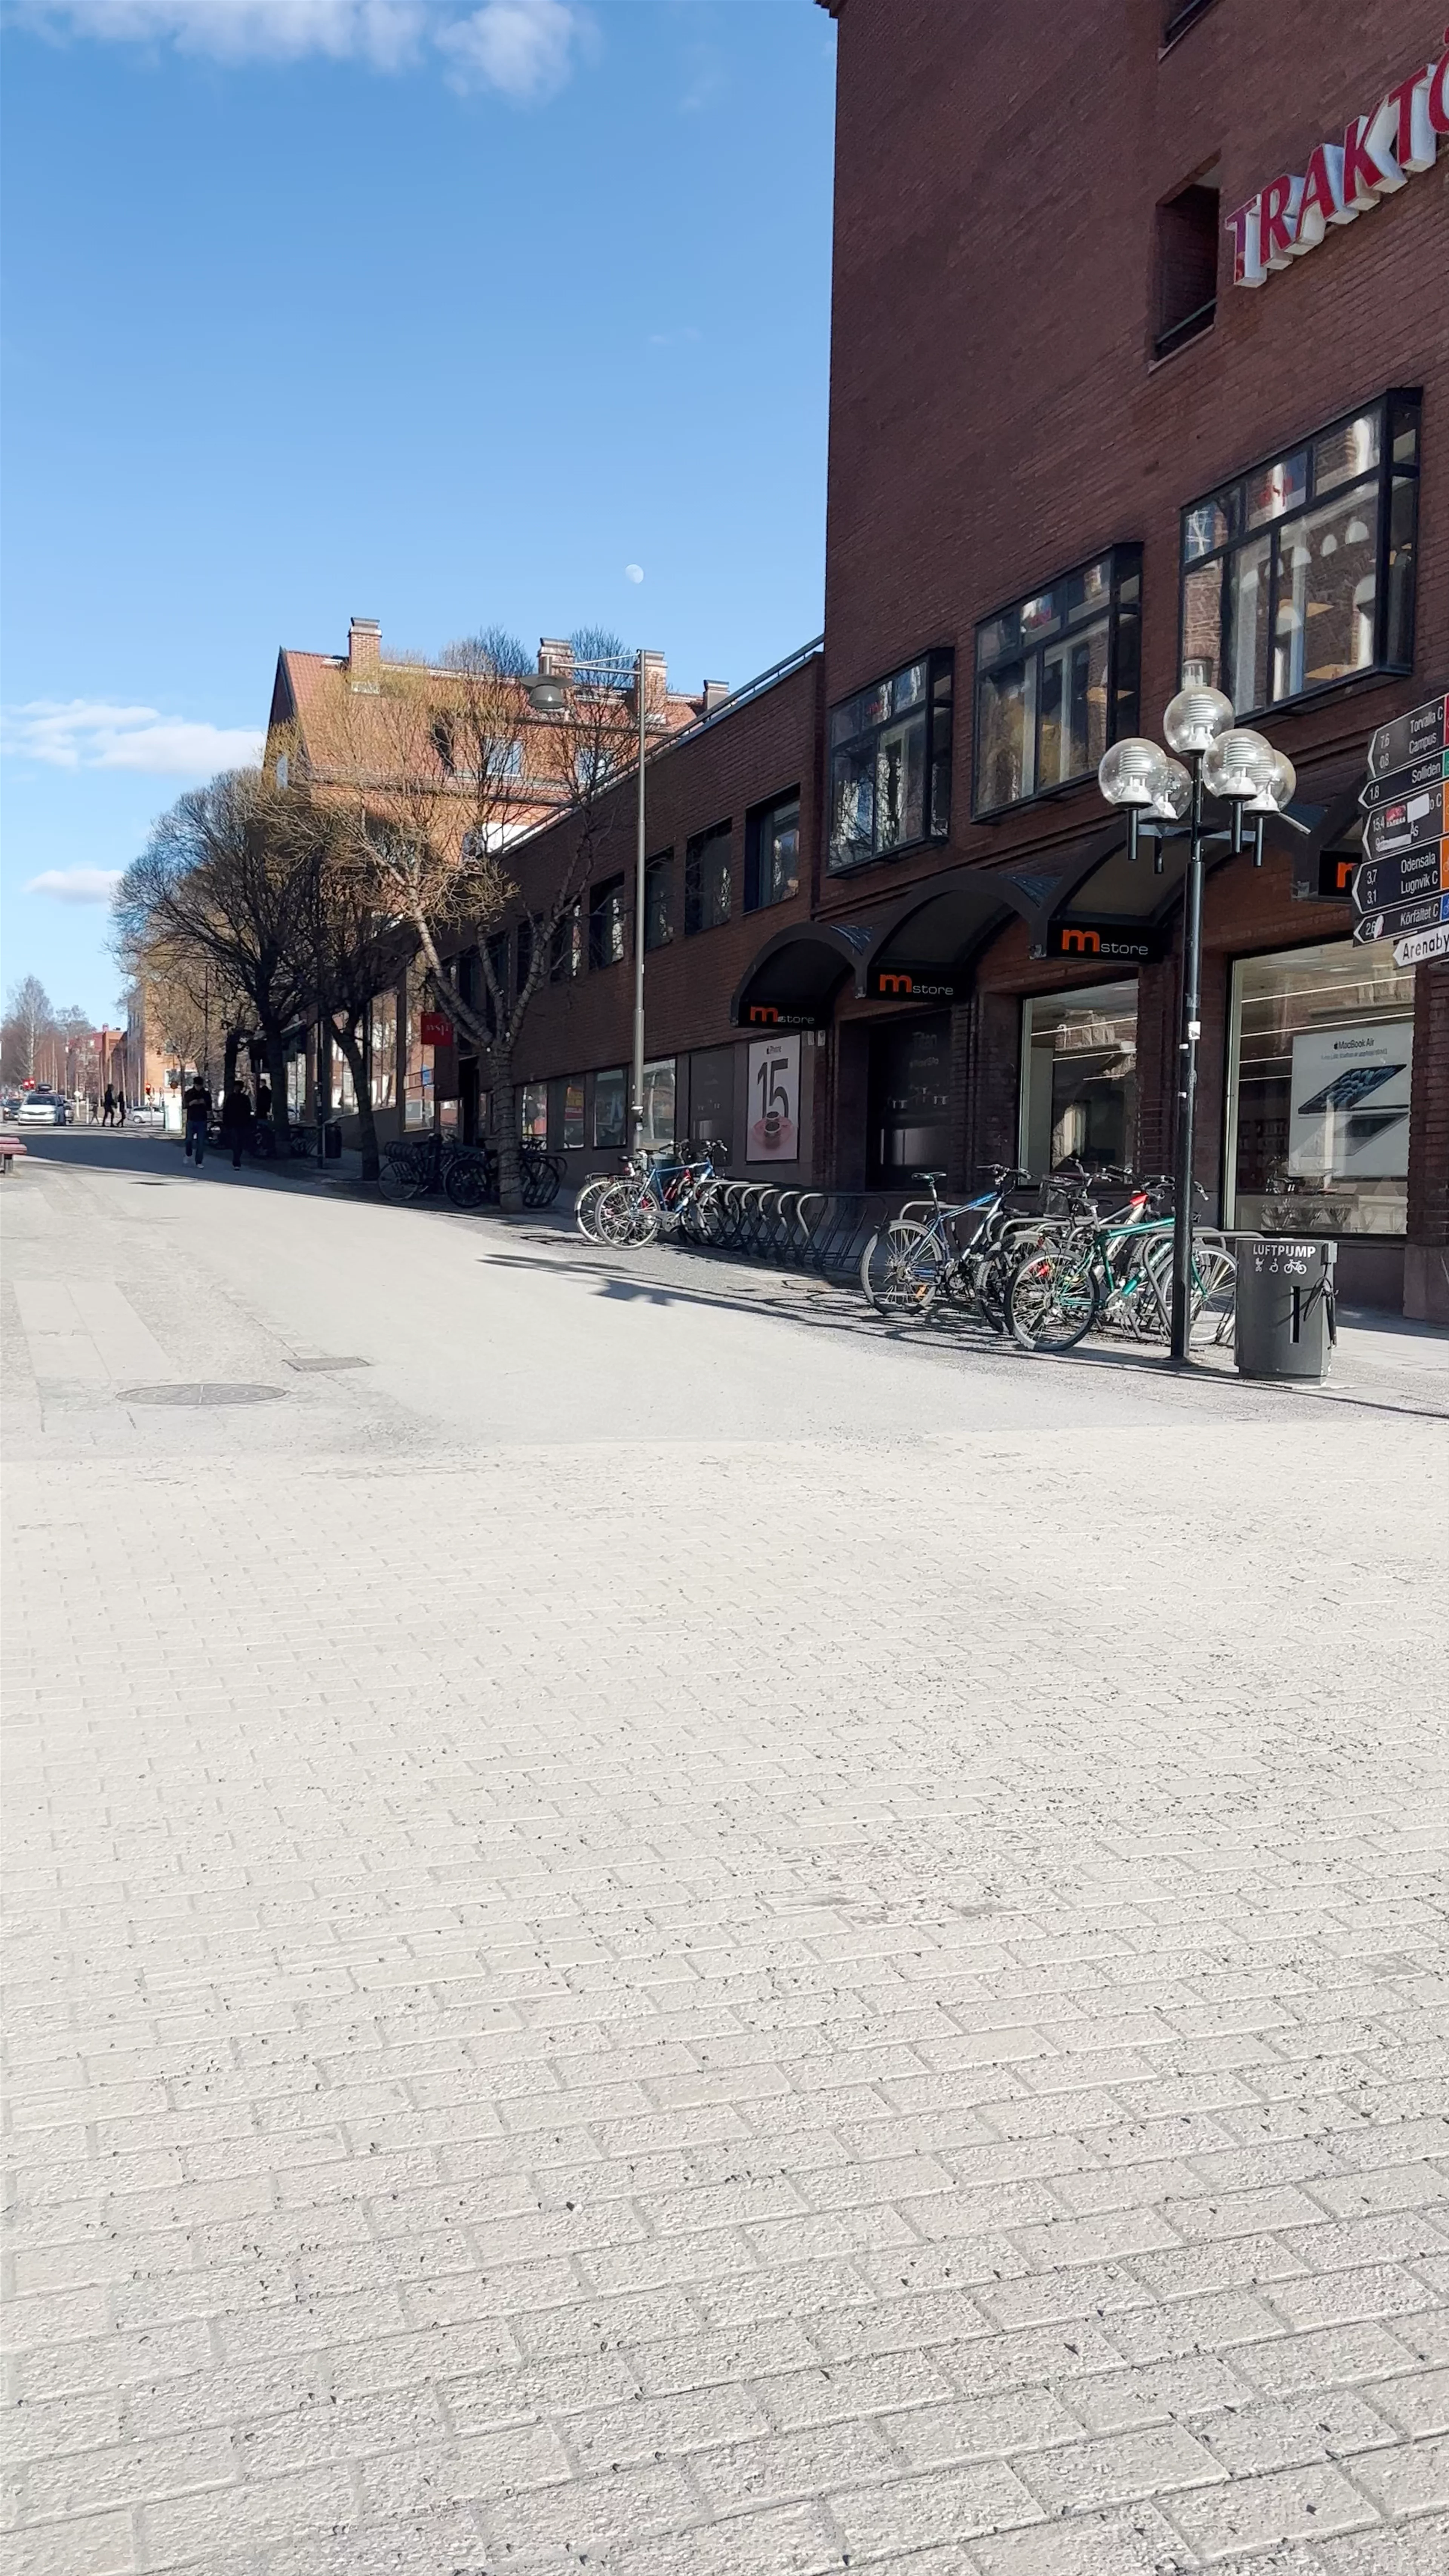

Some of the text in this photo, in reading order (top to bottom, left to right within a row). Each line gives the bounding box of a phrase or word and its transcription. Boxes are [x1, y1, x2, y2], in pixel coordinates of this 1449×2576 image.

[1411, 712, 1436, 733] Torvalla
[1437, 706, 1443, 720] C
[1409, 733, 1437, 754] Campus
[1370, 763, 1441, 800] 1,8 Solliden
[1436, 793, 1442, 807] C
[1367, 869, 1377, 885] 3,7
[1401, 852, 1436, 874] Odensala
[1367, 870, 1438, 905] 3,1 Lugnvik C
[1400, 906, 1431, 926] Körfältet
[1433, 904, 1439, 917] C
[1338, 1039, 1366, 1049] MacBook
[757, 1058, 789, 1119] 15
[1253, 1244, 1316, 1258] LUFTPUMP
